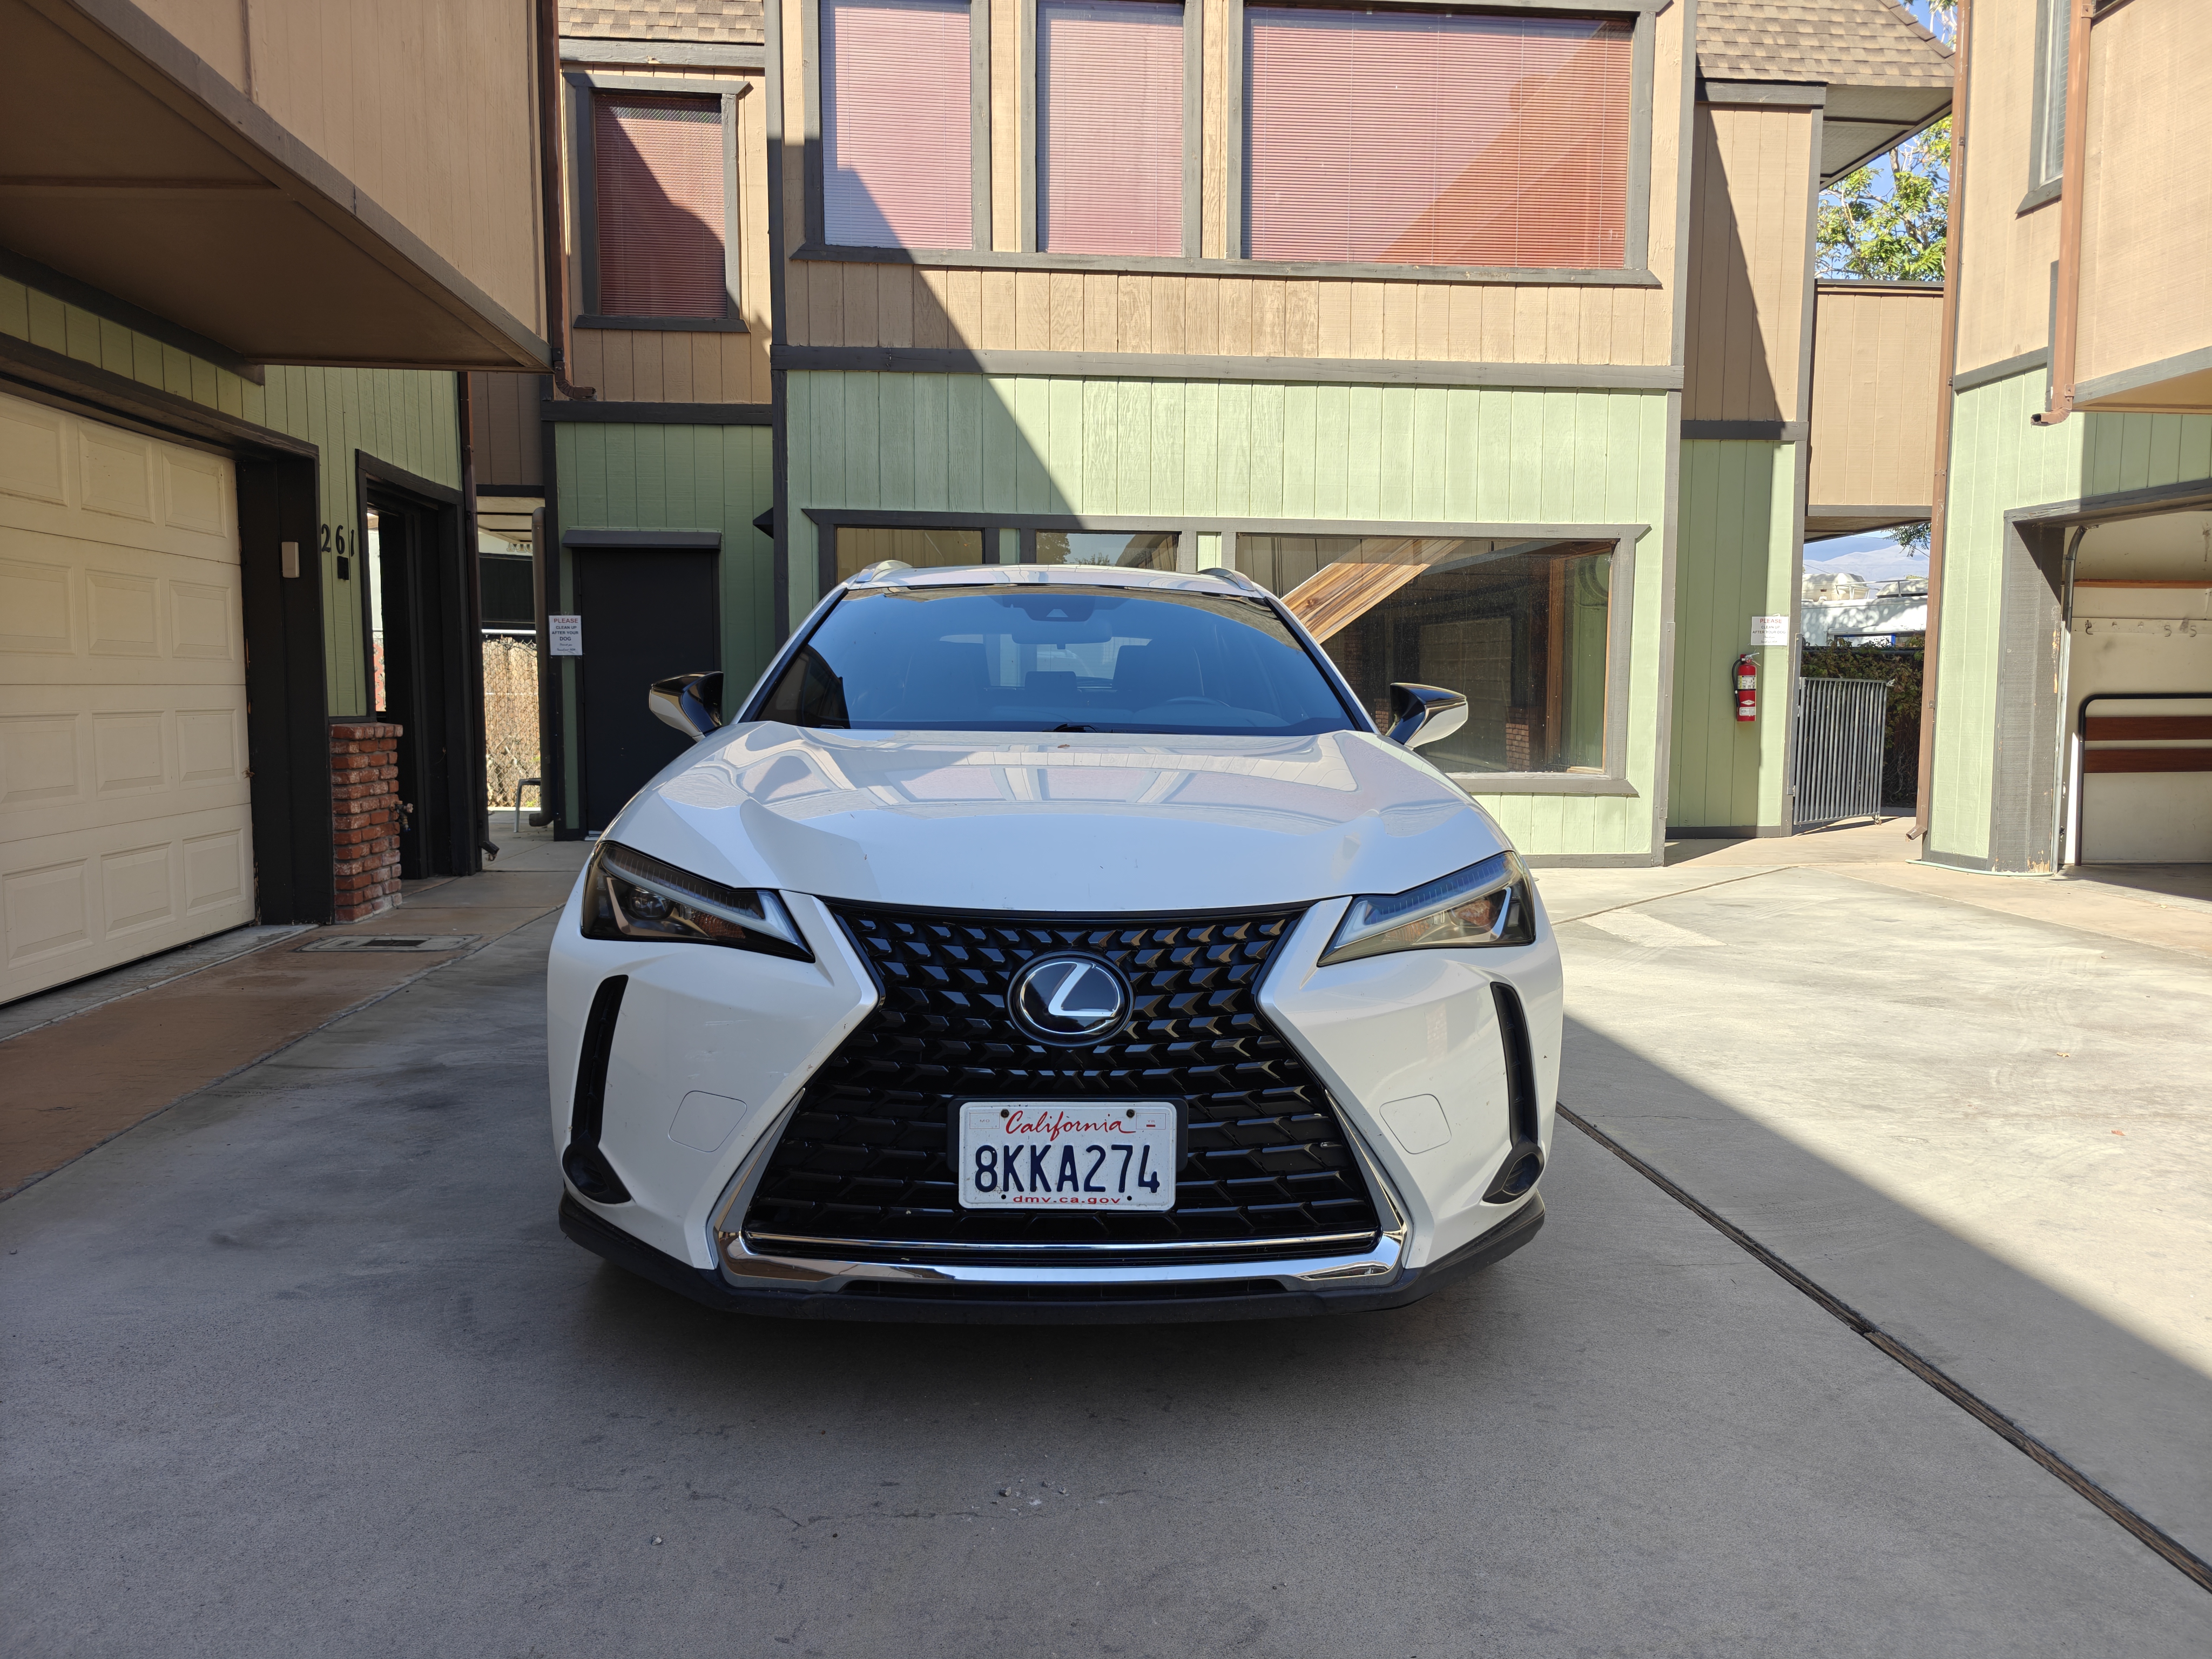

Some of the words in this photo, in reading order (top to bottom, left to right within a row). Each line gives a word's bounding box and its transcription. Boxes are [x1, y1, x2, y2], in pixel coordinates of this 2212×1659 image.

[321, 523, 355, 557] 261
[1005, 1110, 1136, 1142] California
[974, 1144, 1161, 1193] 8KKA274
[1013, 1195, 1121, 1204] dmv.ca.gov
